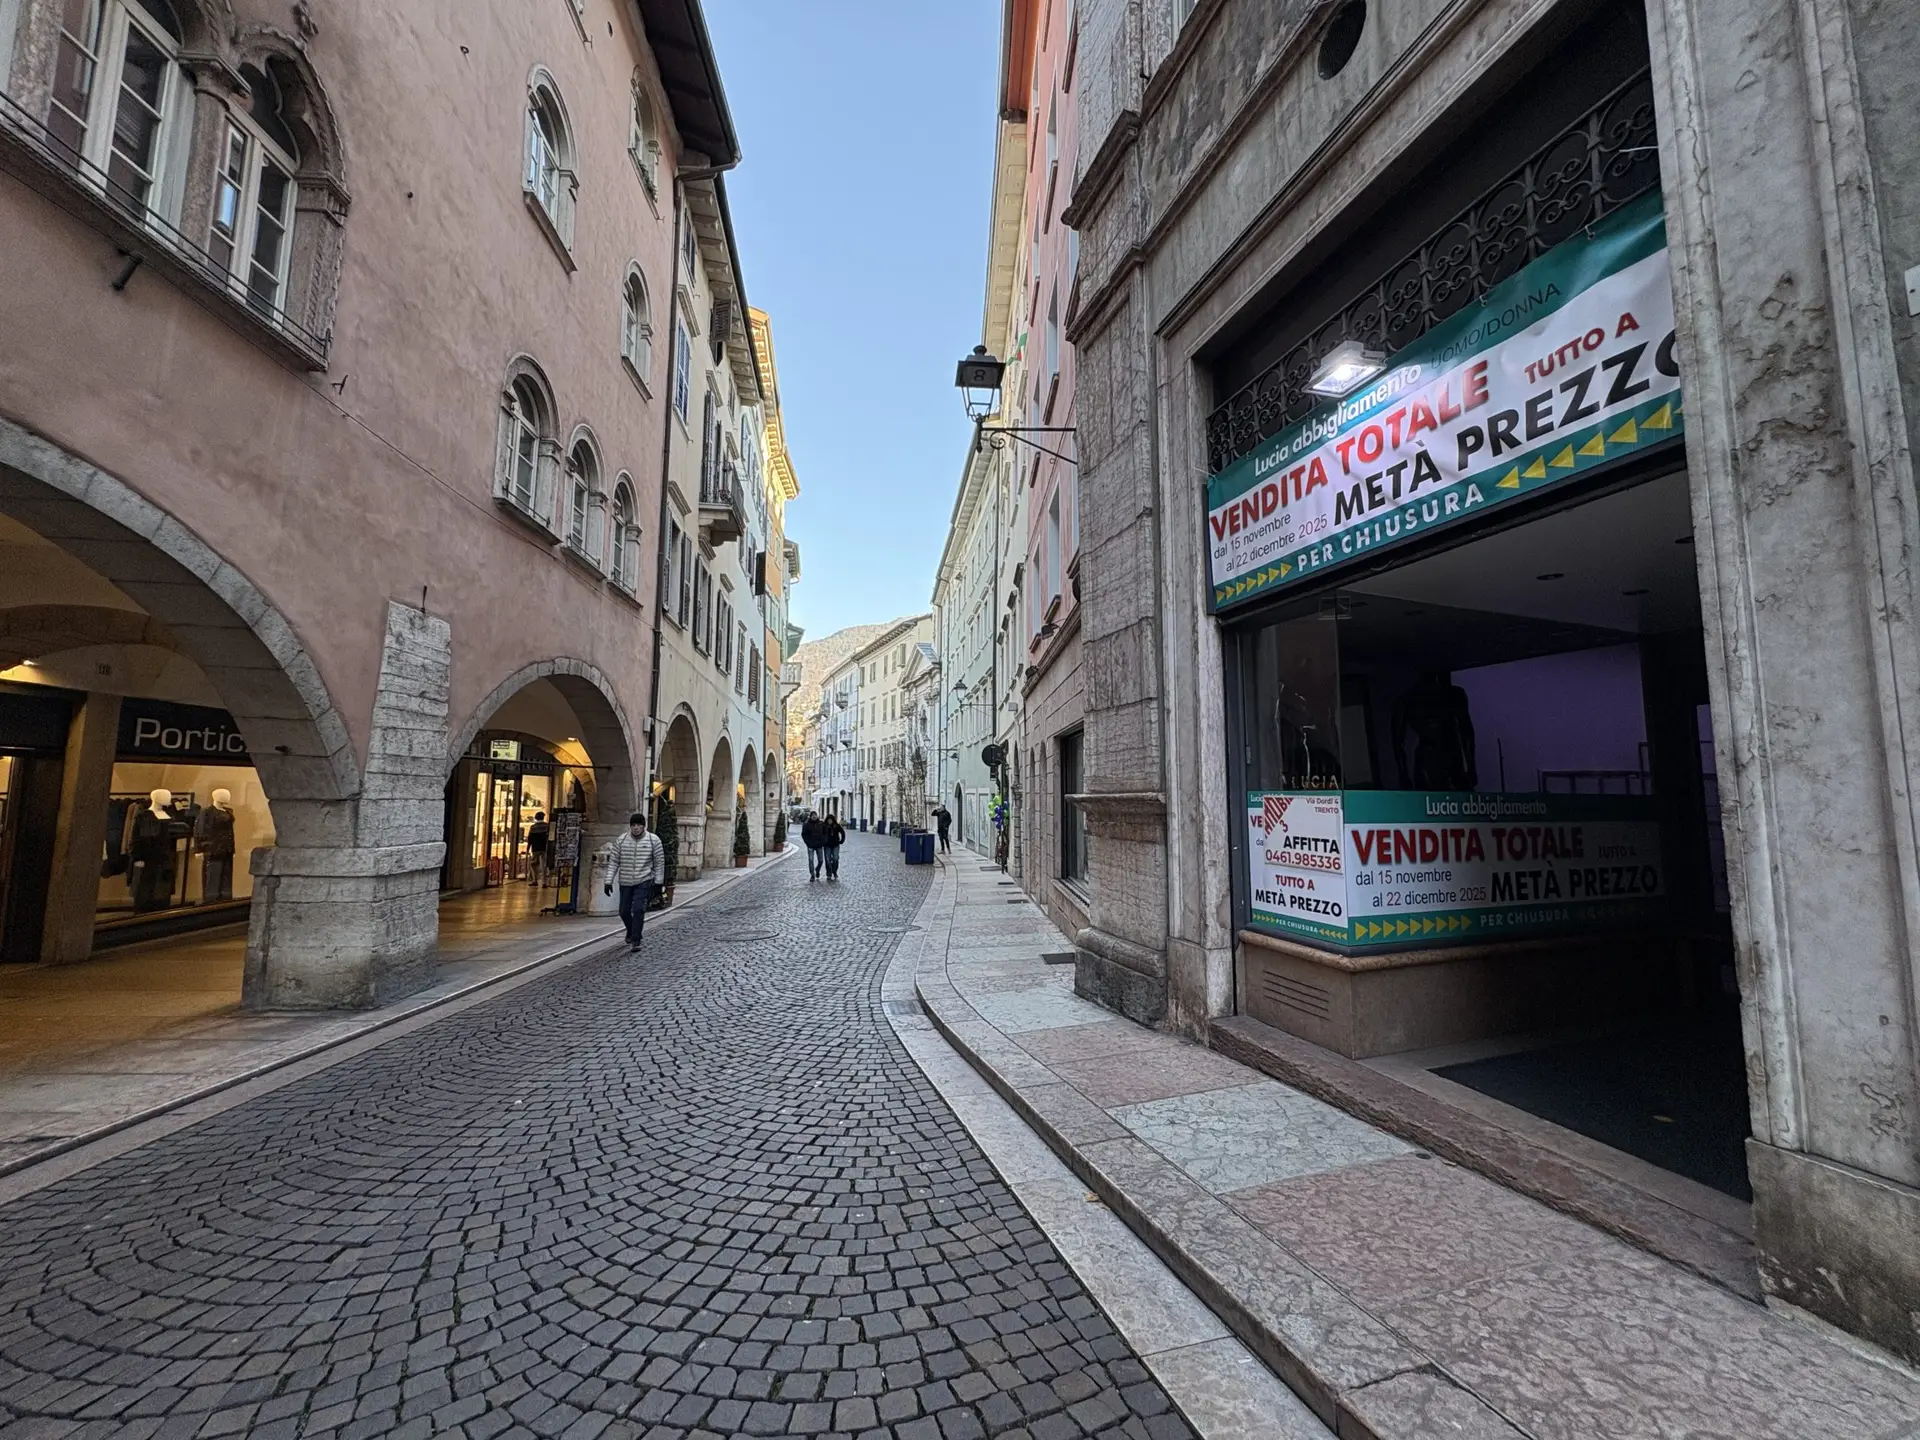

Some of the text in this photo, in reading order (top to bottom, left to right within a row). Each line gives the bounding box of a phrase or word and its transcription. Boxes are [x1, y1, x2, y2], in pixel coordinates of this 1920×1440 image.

[1254, 281, 1561, 477] Lucia abbigliamento UOMO/DONNA
[1209, 311, 1640, 541] VENDITA TOTALE TUTTO A
[1213, 541, 1228, 559] dal
[1230, 537, 1241, 552] 15
[1243, 513, 1292, 546] novembre
[1334, 439, 1442, 527] METÀ
[1297, 482, 1485, 572] PER CHIUSURA
[1226, 513, 1328, 573] al 22 dicembre 2025
[133, 717, 250, 753] Portic
[1314, 806, 1339, 814] TRENTO
[1426, 794, 1547, 820] Lucia abbigliamento
[1279, 819, 1289, 833] 3
[1283, 836, 1340, 854] AFFITTA
[1351, 828, 1485, 865] VENDITA
[1491, 826, 1585, 862] TOTALE
[1265, 849, 1341, 870] 0461.985336
[1275, 874, 1315, 891] TUTTO A
[1355, 868, 1452, 886] dal 15 novembre
[1372, 860, 1659, 908] al 22 dicembre 2025 METÀ PREZZO
[1255, 888, 1342, 918] METÀ PREZZO
[1276, 918, 1319, 934] PER CHIUSURA
[1480, 908, 1570, 927] PER CHIUSURA
